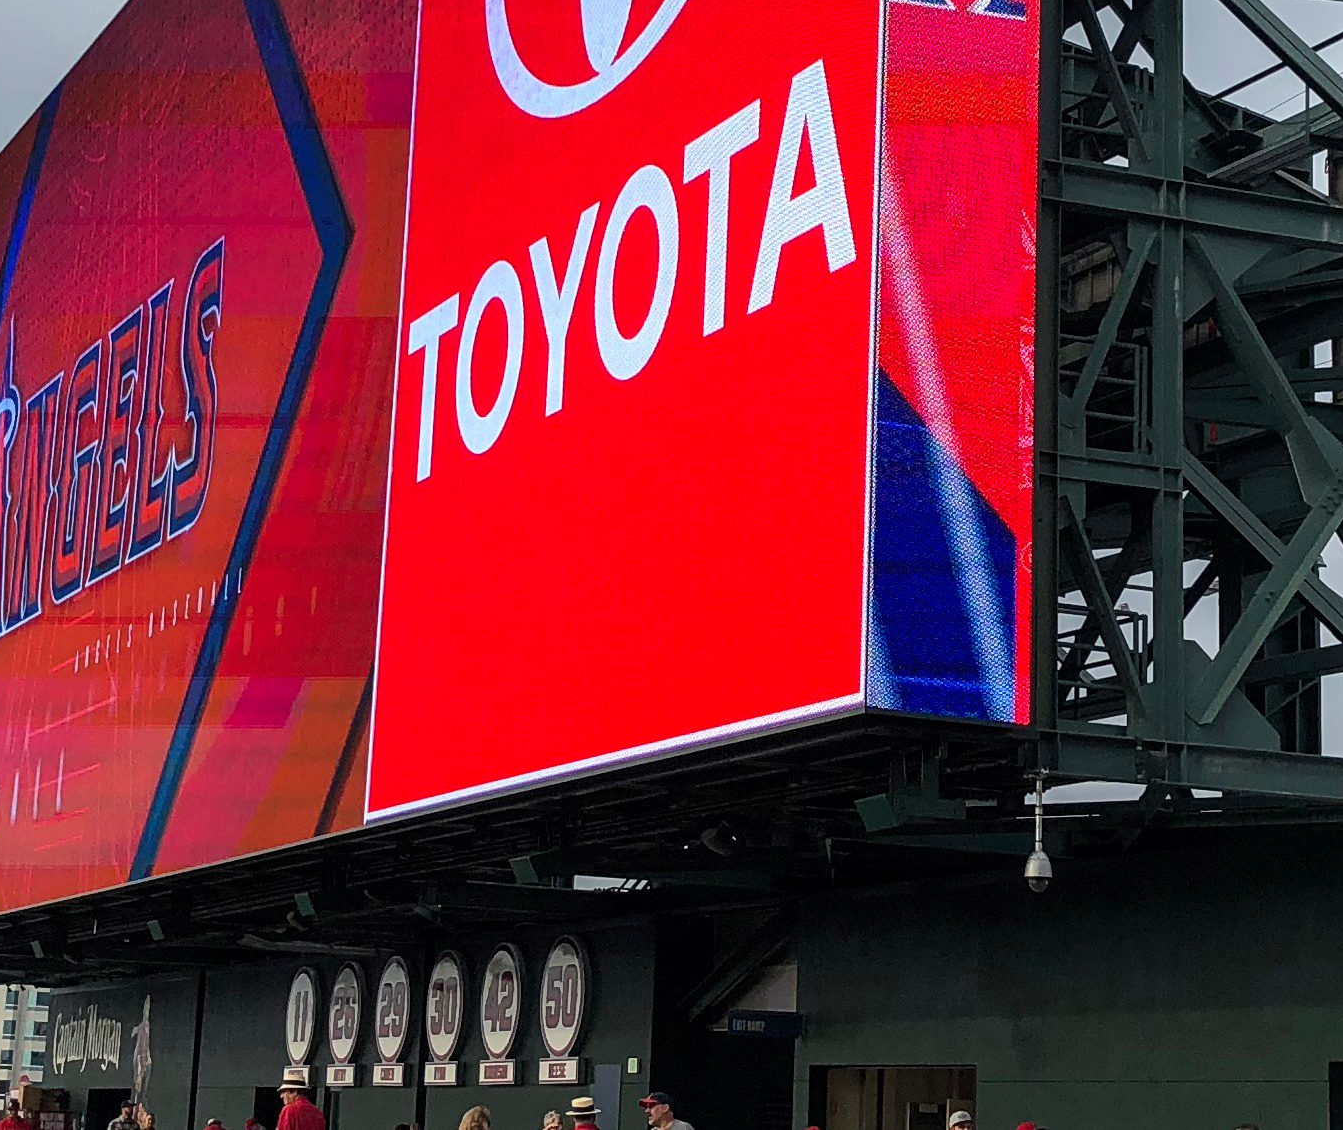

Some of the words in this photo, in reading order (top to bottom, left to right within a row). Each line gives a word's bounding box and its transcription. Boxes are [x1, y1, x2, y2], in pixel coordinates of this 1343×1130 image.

[407, 58, 856, 482] TOYOTA
[293, 990, 309, 1042] 11
[333, 986, 356, 1040] 26
[379, 981, 406, 1038] 29
[430, 977, 457, 1035] 30
[484, 971, 515, 1033] 42
[546, 964, 578, 1029] 50
[53, 1012, 87, 1075] Captain
[79, 1004, 122, 1073] Morgan
